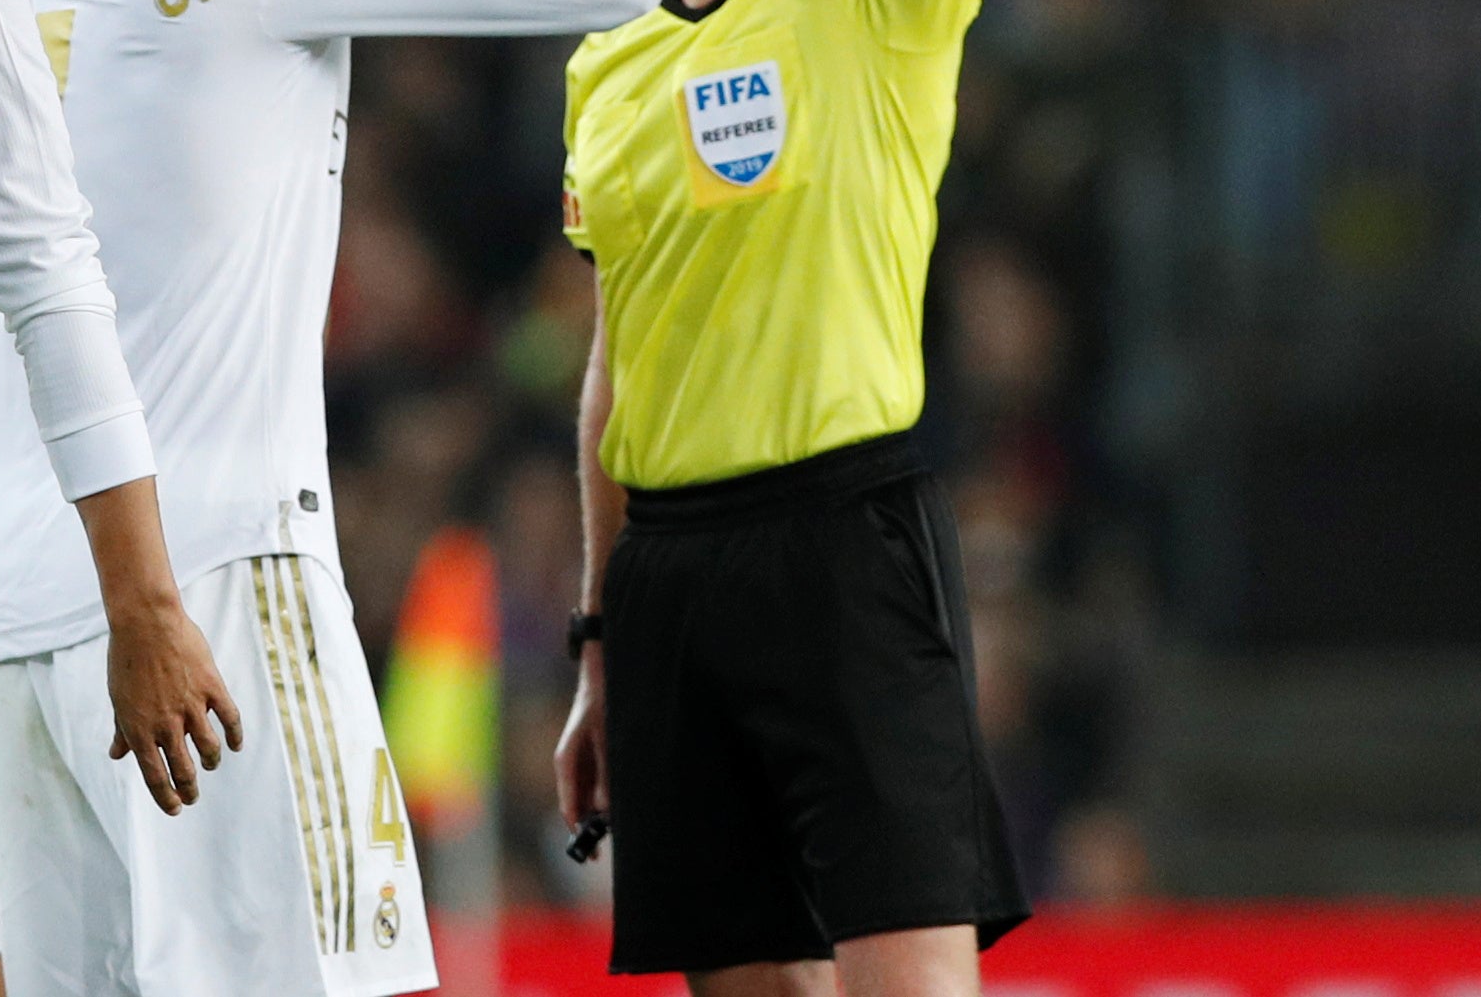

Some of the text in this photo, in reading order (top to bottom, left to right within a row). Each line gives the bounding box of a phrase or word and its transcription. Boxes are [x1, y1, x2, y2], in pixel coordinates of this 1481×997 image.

[695, 73, 771, 111] FIFA
[702, 116, 776, 144] REFEREE
[368, 747, 406, 867] 4
